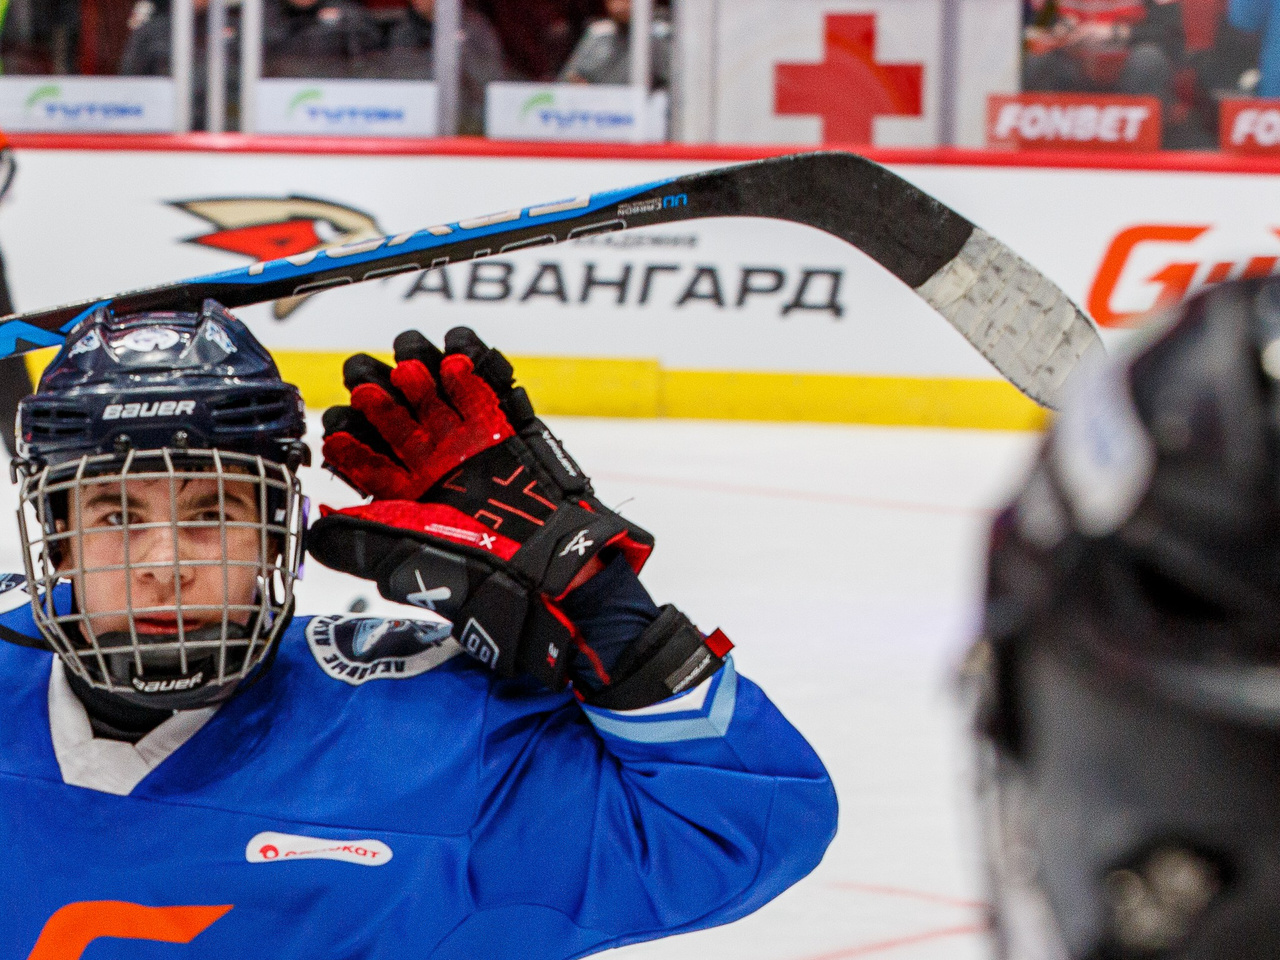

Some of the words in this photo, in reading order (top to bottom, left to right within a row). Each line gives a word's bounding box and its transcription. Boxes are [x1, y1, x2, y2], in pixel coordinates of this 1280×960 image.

[995, 102, 1148, 143] FONBET
[405, 259, 845, 318] АВАНГАРД
[102, 400, 197, 420] BAUER
[132, 671, 204, 693] BAUER
